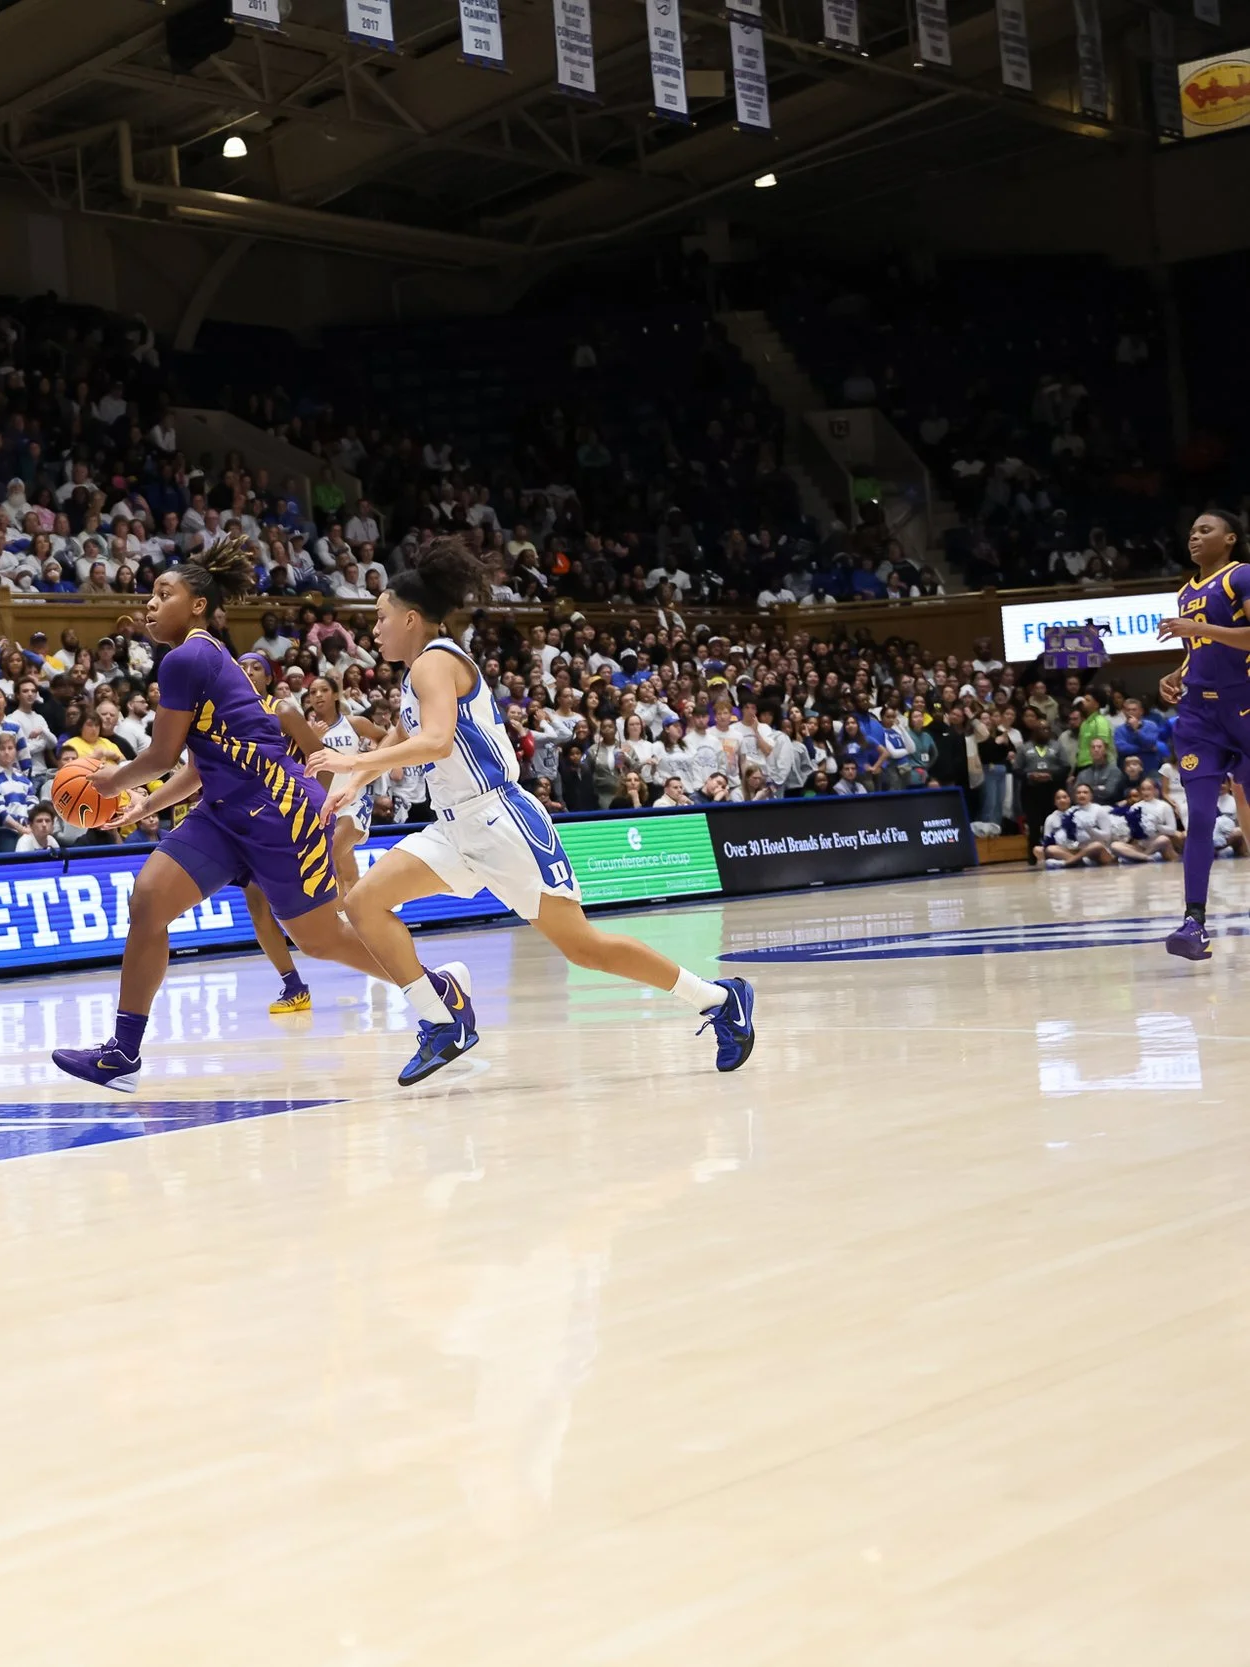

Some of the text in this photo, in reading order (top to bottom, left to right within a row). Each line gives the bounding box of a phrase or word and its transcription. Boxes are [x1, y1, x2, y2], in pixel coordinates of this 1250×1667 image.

[362, 17, 379, 31] 2017
[1181, 596, 1207, 617] LSU
[324, 735, 352, 747] UKE
[923, 818, 951, 828] MARRIOTT
[723, 827, 908, 859] Over 30 Hotel Brands for Every Kind of Fan
[921, 828, 960, 846] BONVOY
[587, 851, 690, 872] Circumference Group
